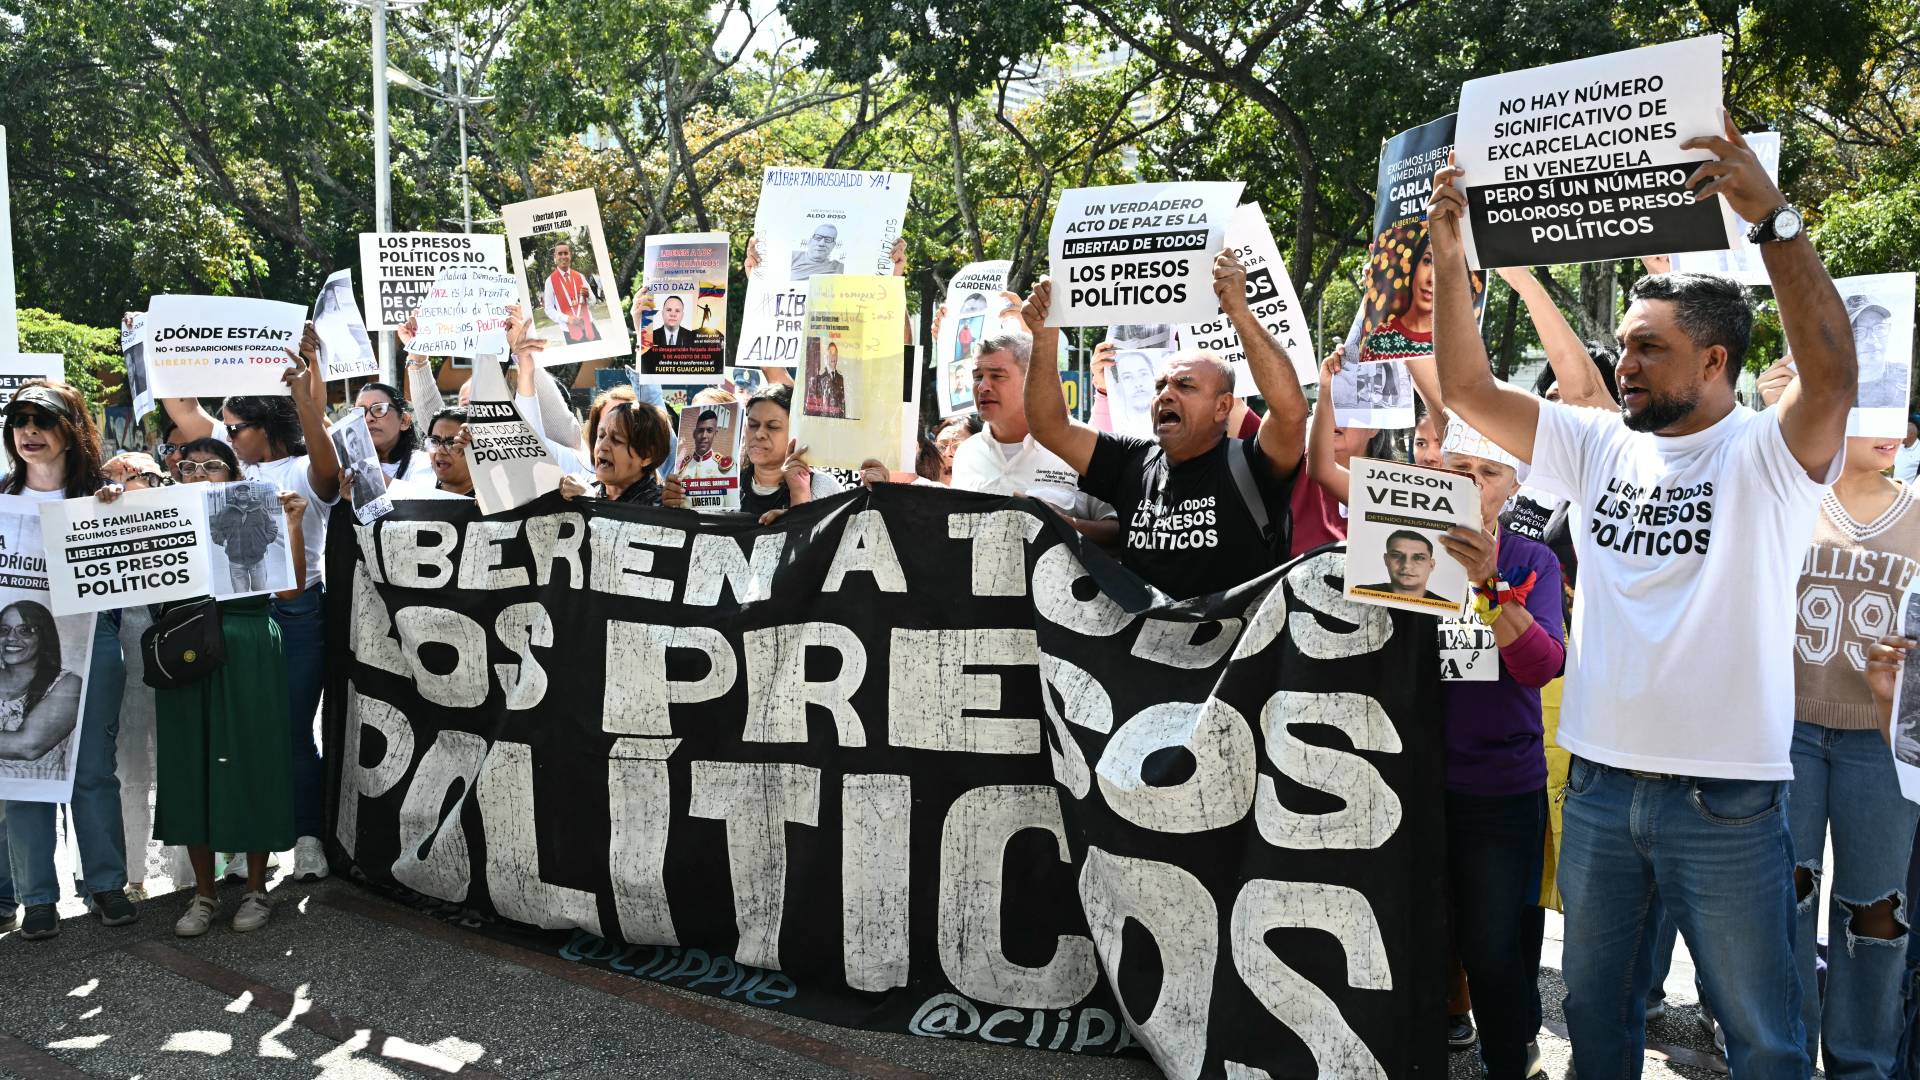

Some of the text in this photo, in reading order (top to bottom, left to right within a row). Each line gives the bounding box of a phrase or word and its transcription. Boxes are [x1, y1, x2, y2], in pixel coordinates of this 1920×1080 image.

[1499, 75, 1664, 115] NO HAY NÚMERO
[1494, 98, 1667, 138] SIGNIFICATIVO DE
[1488, 122, 1677, 161] EXCARCELACIONES
[1387, 153, 1424, 175] EXIGIMOS
[1390, 162, 1433, 184] INMEDIATA
[1504, 150, 1652, 181] EN VENEZUELA
[869, 173, 891, 190] YA!
[1390, 177, 1432, 202] CARLA
[1484, 169, 1686, 205] PERO SÍ UN NÚMERO
[533, 210, 567, 222] Libertad para
[1084, 198, 1204, 217] UN VERDADERO
[1487, 190, 1696, 224] DOLOROSO DE PRESOS
[532, 222, 553, 233] KENNEDY
[1066, 213, 1208, 234] ACTO DE PAZ ES LA
[1531, 216, 1654, 243] POLÍTICOS
[378, 237, 471, 249] LOS PRESOS
[1064, 233, 1206, 256] LIBERTAD DE TODOS
[379, 249, 485, 263] POLÍTICOS NO
[380, 265, 435, 277] TIENEN
[960, 273, 1001, 282] JHOLMAR
[1070, 259, 1189, 283] LOS PRESOS
[381, 282, 392, 294] A
[671, 283, 695, 291] DAZA
[955, 281, 1004, 291] CARDENAS
[1071, 281, 1187, 308] POLÍTICOS
[383, 296, 403, 308] DE
[154, 324, 223, 342] ¿DÓNDE
[227, 326, 293, 341] ESTÁN?
[1191, 319, 1222, 336] LOS
[175, 345, 243, 353] DESAPARICIONES
[743, 335, 799, 361] ALDO
[154, 357, 288, 367] LIBERTAD PARA TODOS
[490, 423, 530, 436] TODOS
[470, 435, 539, 450] LOS PRESOS
[474, 445, 547, 465] POLÍTICOS
[1366, 469, 1453, 491] JACKSON
[691, 497, 721, 507] LIBERTAD
[1366, 486, 1455, 515] VERA
[1649, 486, 1661, 502] A
[1666, 481, 1713, 503] TODOS
[73, 507, 179, 532] LOS FAMILIARES
[1153, 510, 1217, 531] PRESOS
[1366, 513, 1403, 525] DETENIDO
[1594, 494, 1712, 526] LOS PRESOS
[65, 518, 192, 543] SEGUIMOS ESPERANDO LA
[1128, 528, 1219, 550] POLÍTICOS
[1591, 519, 1711, 556] POLÍTICOS
[67, 534, 195, 561] LIBERTAD DE TODOS
[821, 510, 908, 593] A
[74, 551, 189, 579] LOS PRESOS
[77, 568, 190, 599] POLÍTICOS
[1794, 583, 1897, 672] 99
[349, 559, 1403, 850] LOS PRESOS
[337, 679, 1394, 1080] POLÍTICOS
